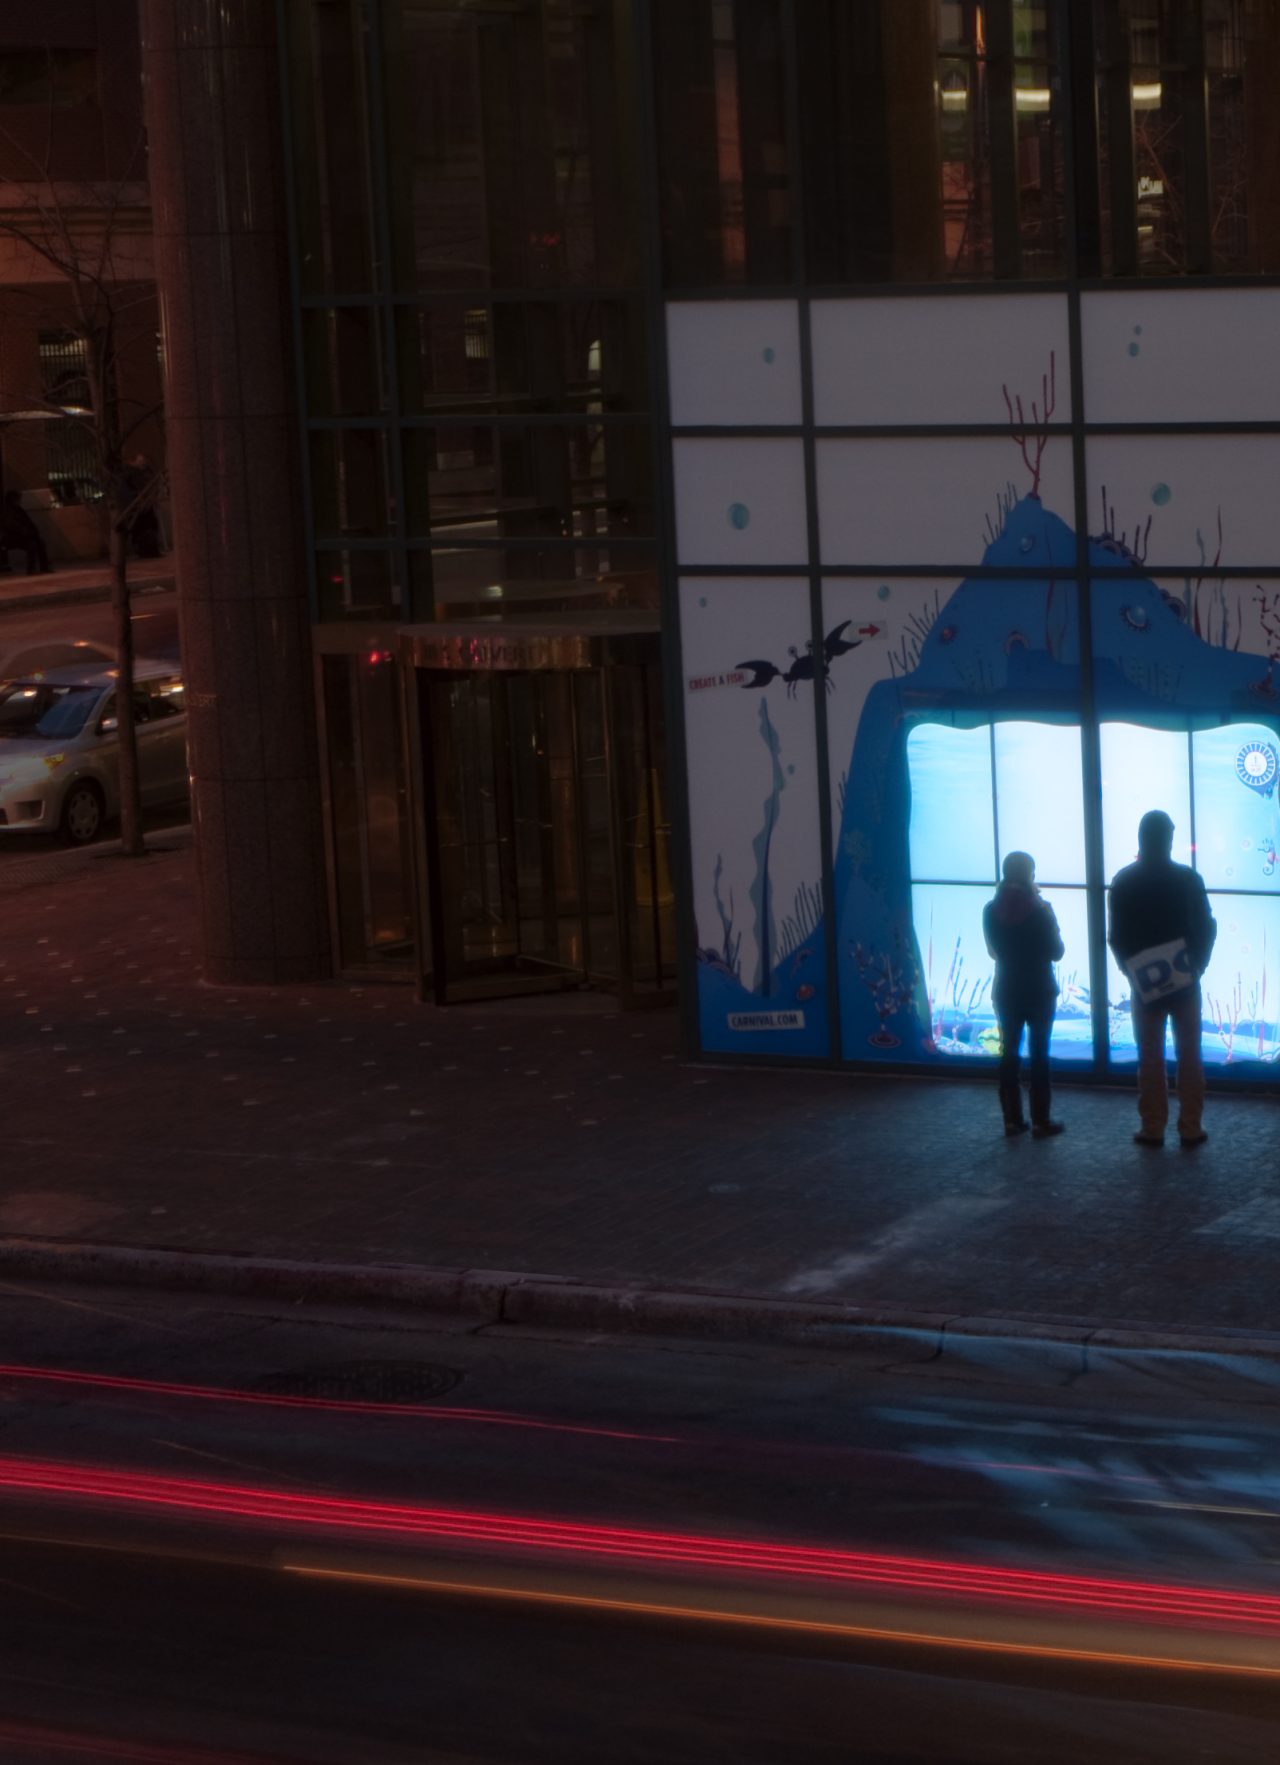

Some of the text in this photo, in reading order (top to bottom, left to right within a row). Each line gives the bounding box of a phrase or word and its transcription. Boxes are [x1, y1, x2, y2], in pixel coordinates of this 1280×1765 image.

[689, 672, 745, 690] CREATE A FISH
[732, 1014, 798, 1027] CARNIVAL.COM
